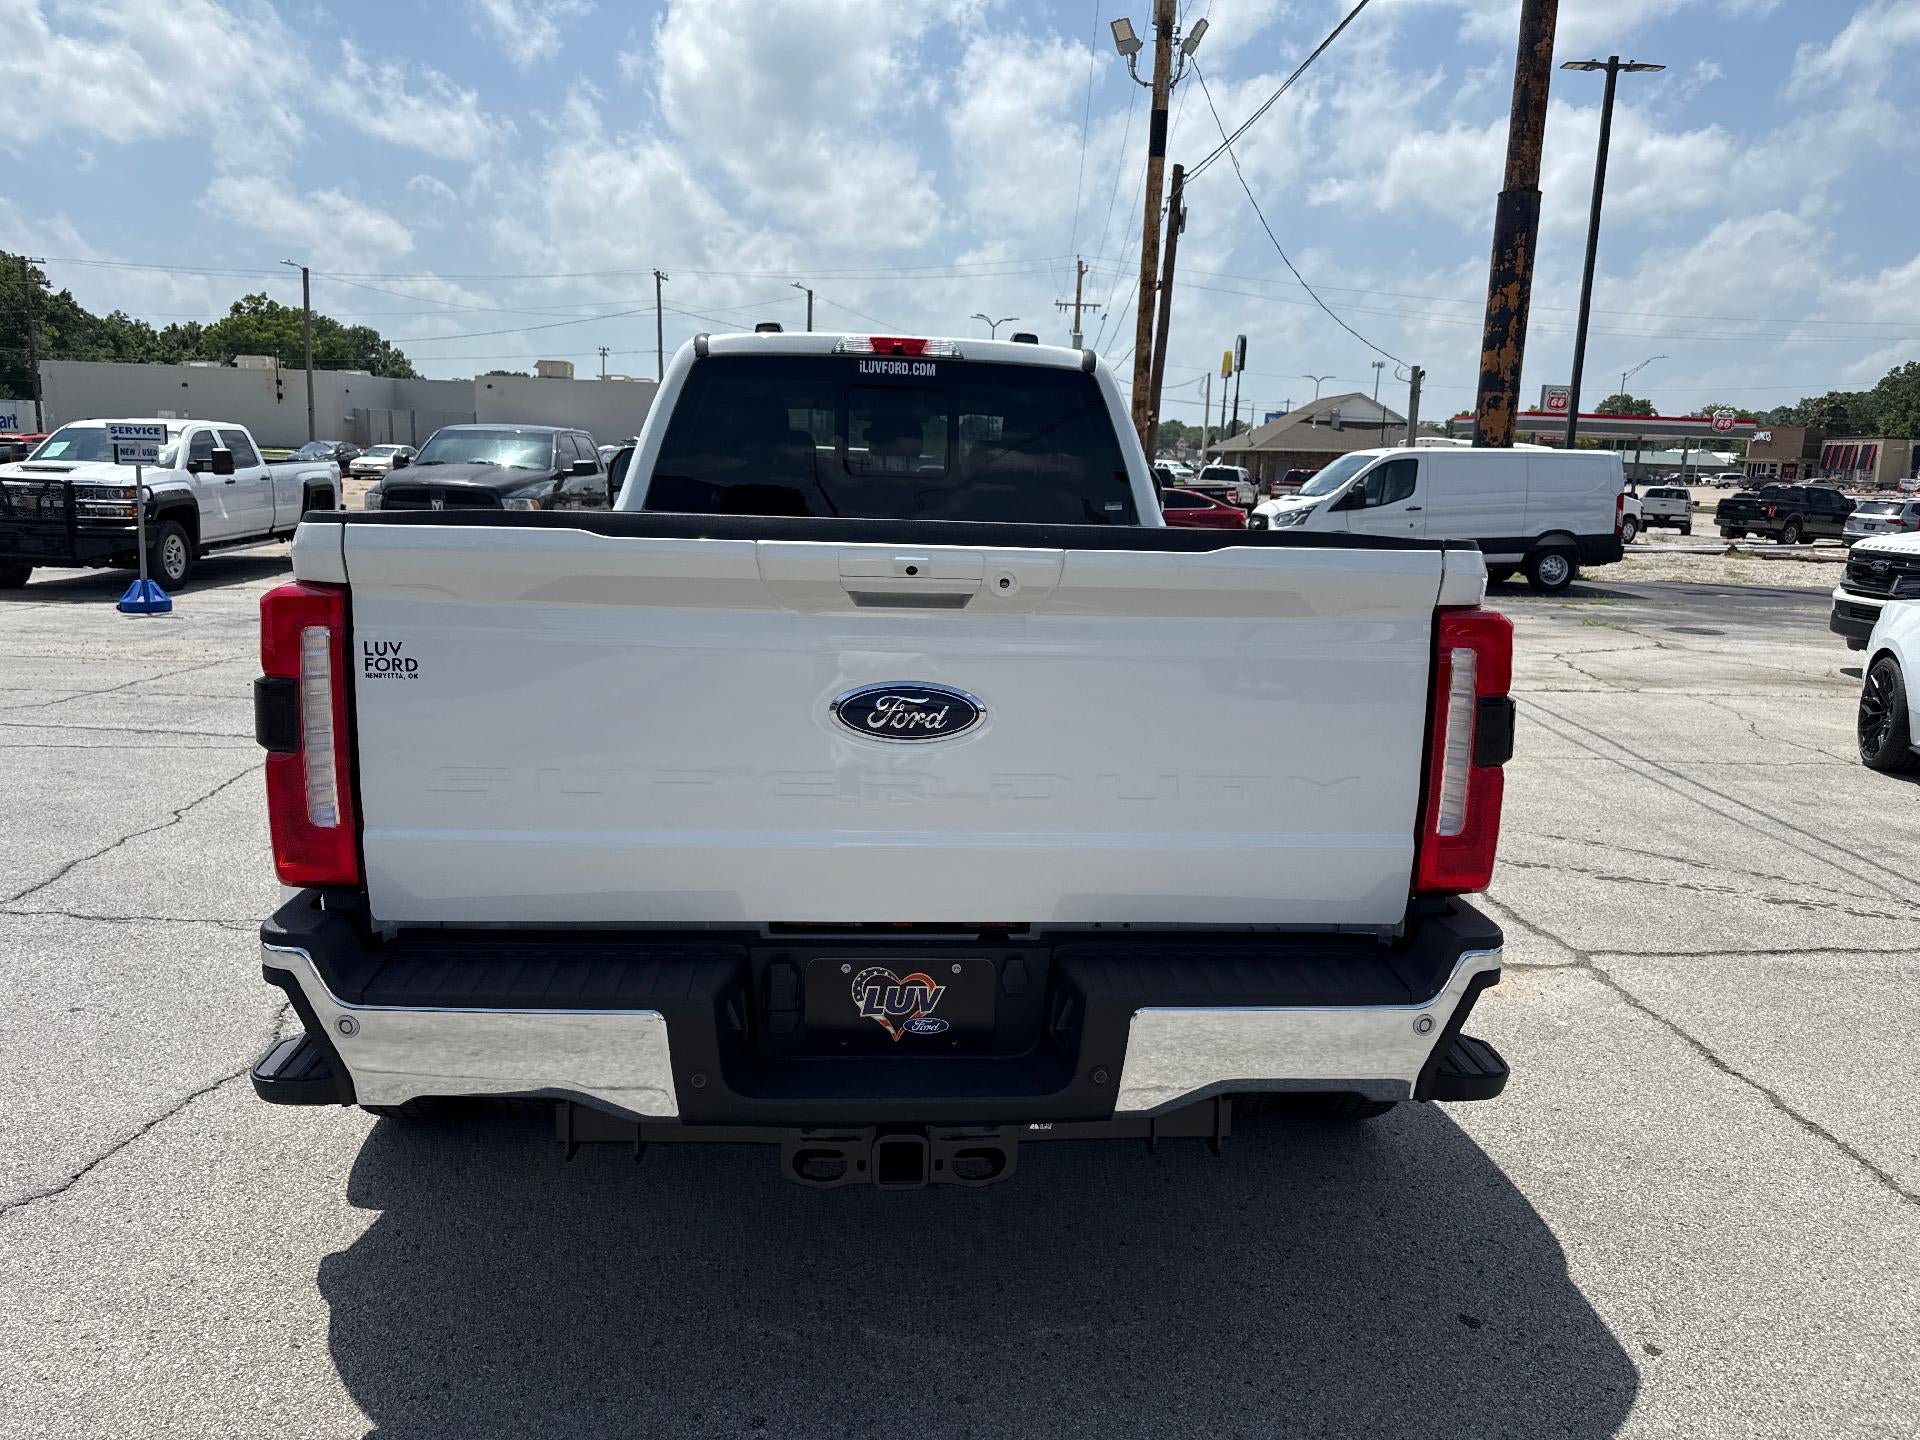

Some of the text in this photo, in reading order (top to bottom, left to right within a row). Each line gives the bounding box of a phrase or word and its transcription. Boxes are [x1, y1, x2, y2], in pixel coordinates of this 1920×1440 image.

[860, 360, 936, 376] iLUVFORD.COM
[1550, 398, 1566, 407] 66
[1717, 419, 1732, 429] 66
[110, 426, 161, 435] SERVICE
[120, 448, 136, 456] NEW
[142, 448, 158, 457] USED
[363, 641, 403, 656] LUV
[364, 657, 419, 672] FORD
[365, 672, 419, 680] HENRYETTA, OK
[866, 695, 950, 729] Ford
[860, 985, 947, 1017] LUV
[911, 1020, 941, 1032] Ford
